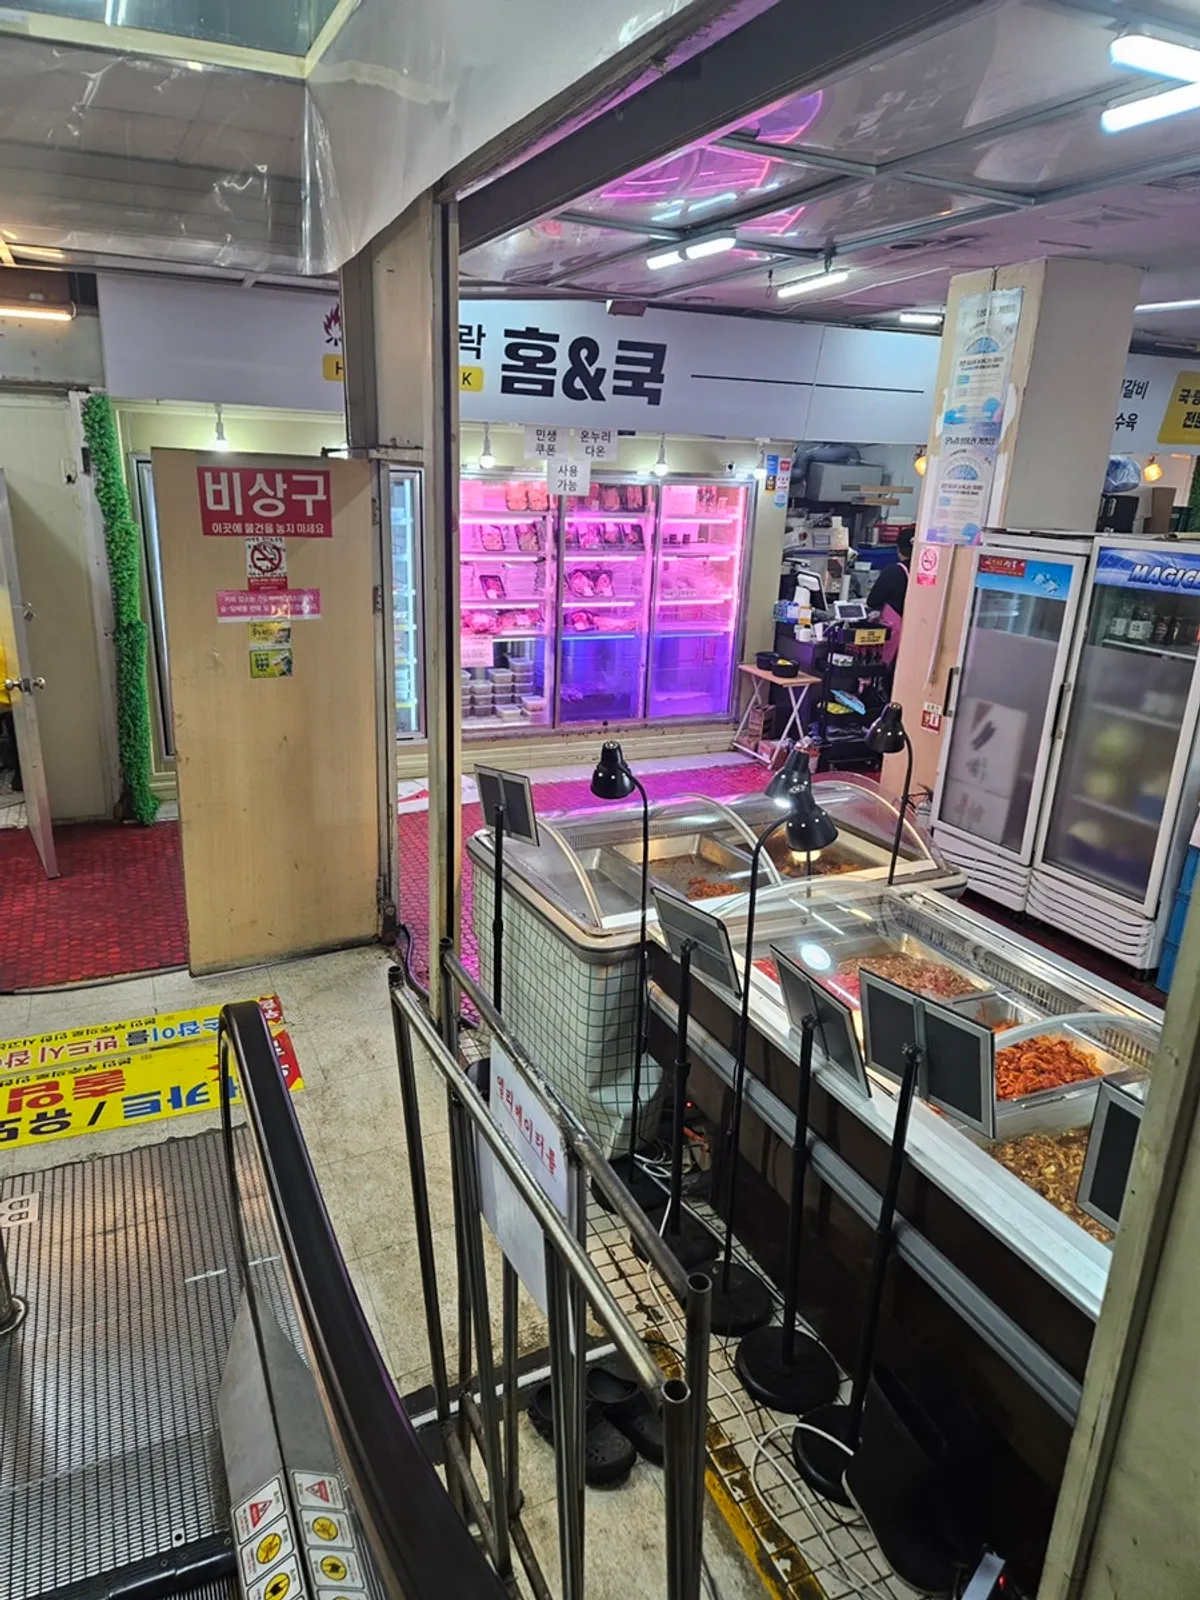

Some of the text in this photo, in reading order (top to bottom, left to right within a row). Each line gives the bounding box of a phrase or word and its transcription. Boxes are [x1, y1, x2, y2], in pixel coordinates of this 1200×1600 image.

[500, 326, 668, 406] 홈&쿡
[462, 371, 472, 386] K
[1114, 412, 1139, 432] 수육
[535, 428, 558, 442] 민생
[579, 429, 611, 443] 온누리
[535, 443, 556, 456] 쿠폰
[585, 445, 606, 457] 다온
[557, 464, 579, 477] 사용
[557, 479, 577, 491] 가능
[204, 471, 327, 518] 비상구
[211, 522, 325, 535] 이곳에 물건을 놓지 마세요
[38, 1034, 119, 1064] 반드시
[6, 1069, 126, 1115] 출입
